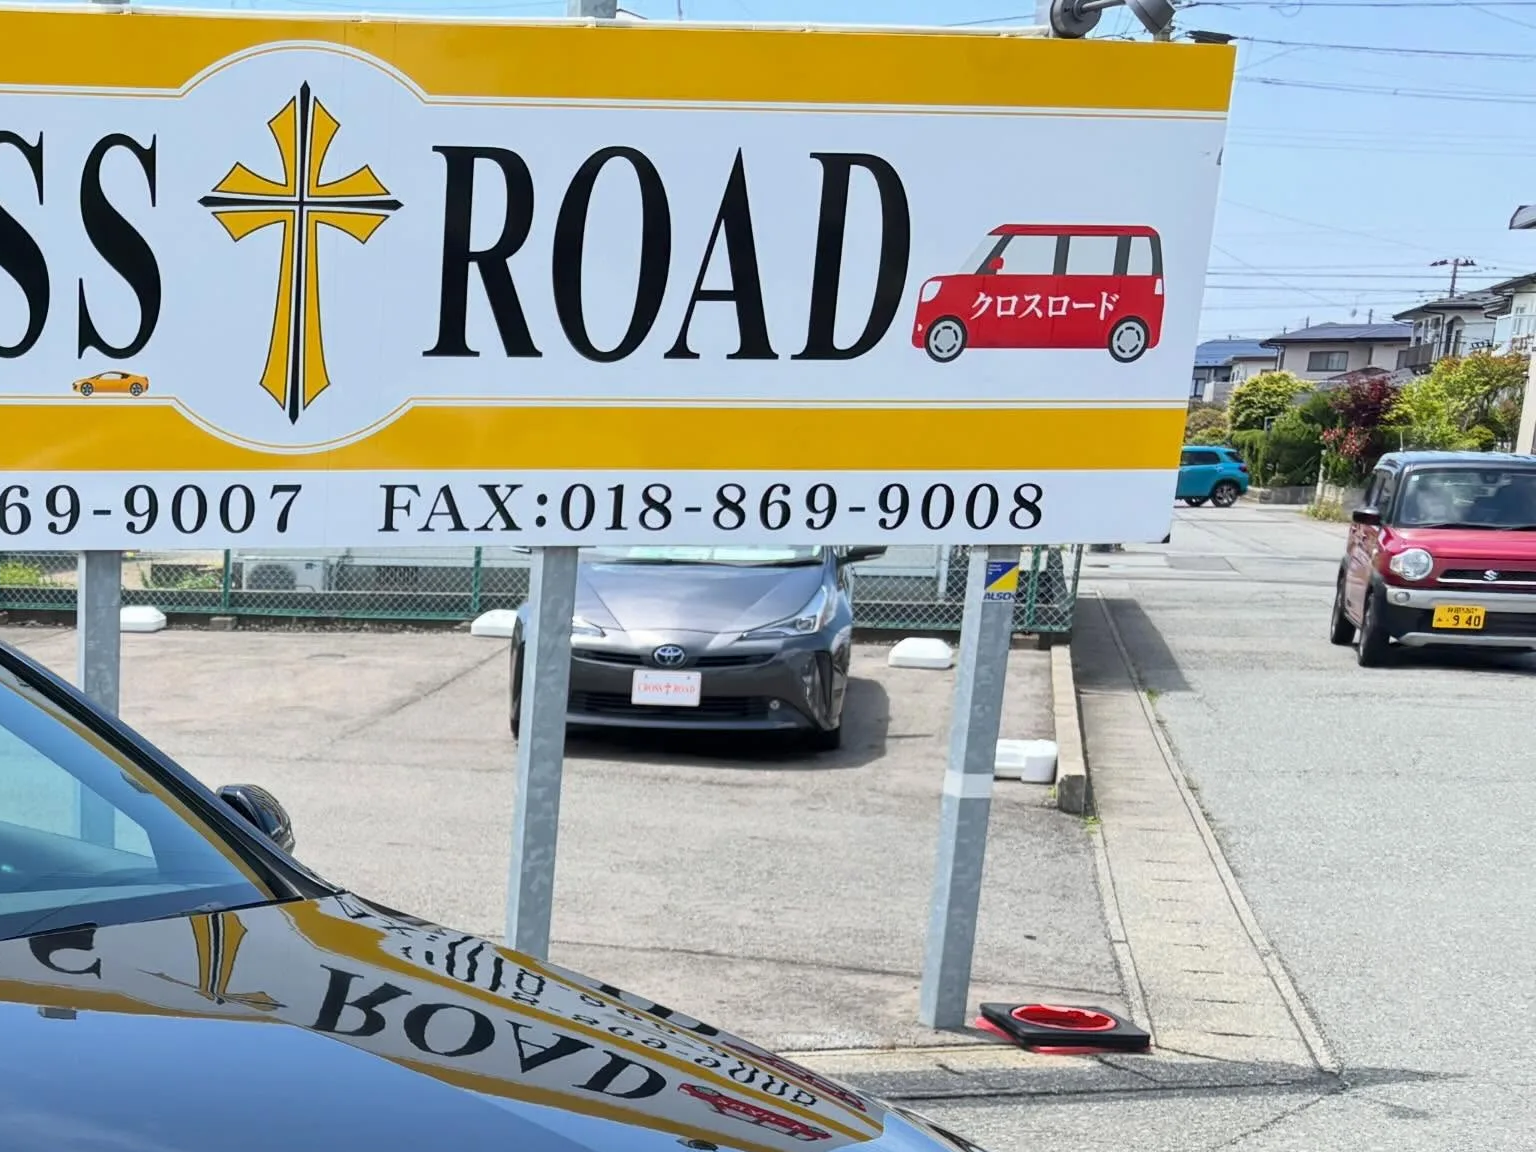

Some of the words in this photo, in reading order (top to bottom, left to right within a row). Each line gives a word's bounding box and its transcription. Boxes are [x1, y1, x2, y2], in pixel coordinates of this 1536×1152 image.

[422, 146, 911, 363] ROAD
[970, 291, 1120, 321] クロスロード
